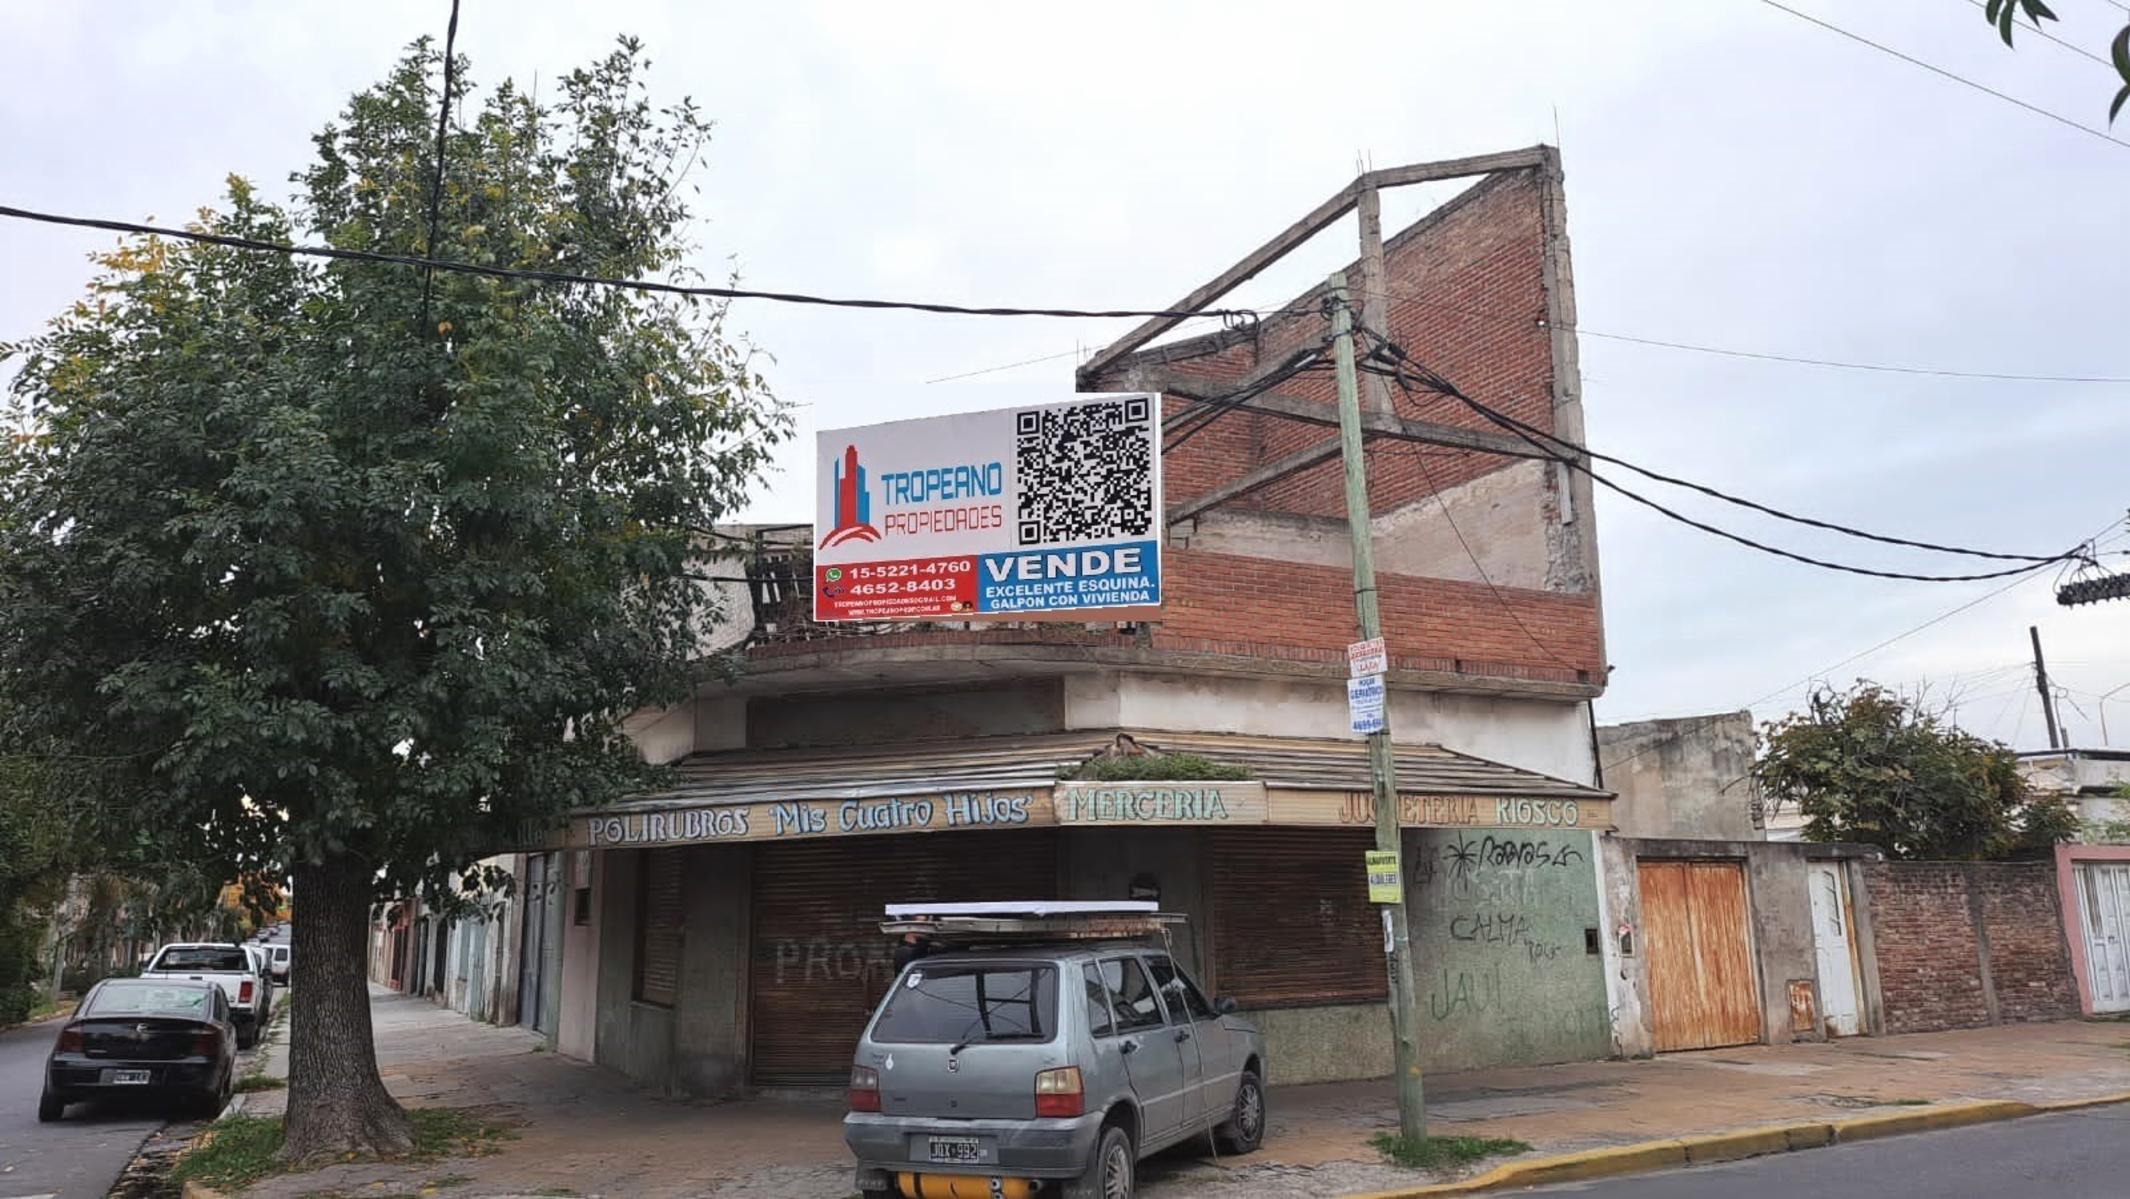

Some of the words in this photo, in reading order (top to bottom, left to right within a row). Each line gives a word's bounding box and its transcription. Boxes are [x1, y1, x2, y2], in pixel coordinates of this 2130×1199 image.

[880, 462, 1002, 505] TROPEANO
[885, 505, 1002, 536] PROPIEDADES
[849, 560, 971, 580] 15-5221-4760
[985, 547, 1142, 583] VENDE
[850, 578, 956, 596] 4652-8403
[985, 581, 1074, 598] EXCELENTE
[990, 597, 1046, 610] GALPON
[1050, 593, 1078, 607] CON
[1082, 590, 1150, 604] VIVIENDA
[838, 798, 934, 832] Cuatro
[1066, 788, 1229, 821] MERCERIA
[1495, 797, 1577, 826] KIOSCO
[588, 808, 750, 847] POLIRUBROS
[957, 1143, 977, 1159] 992
